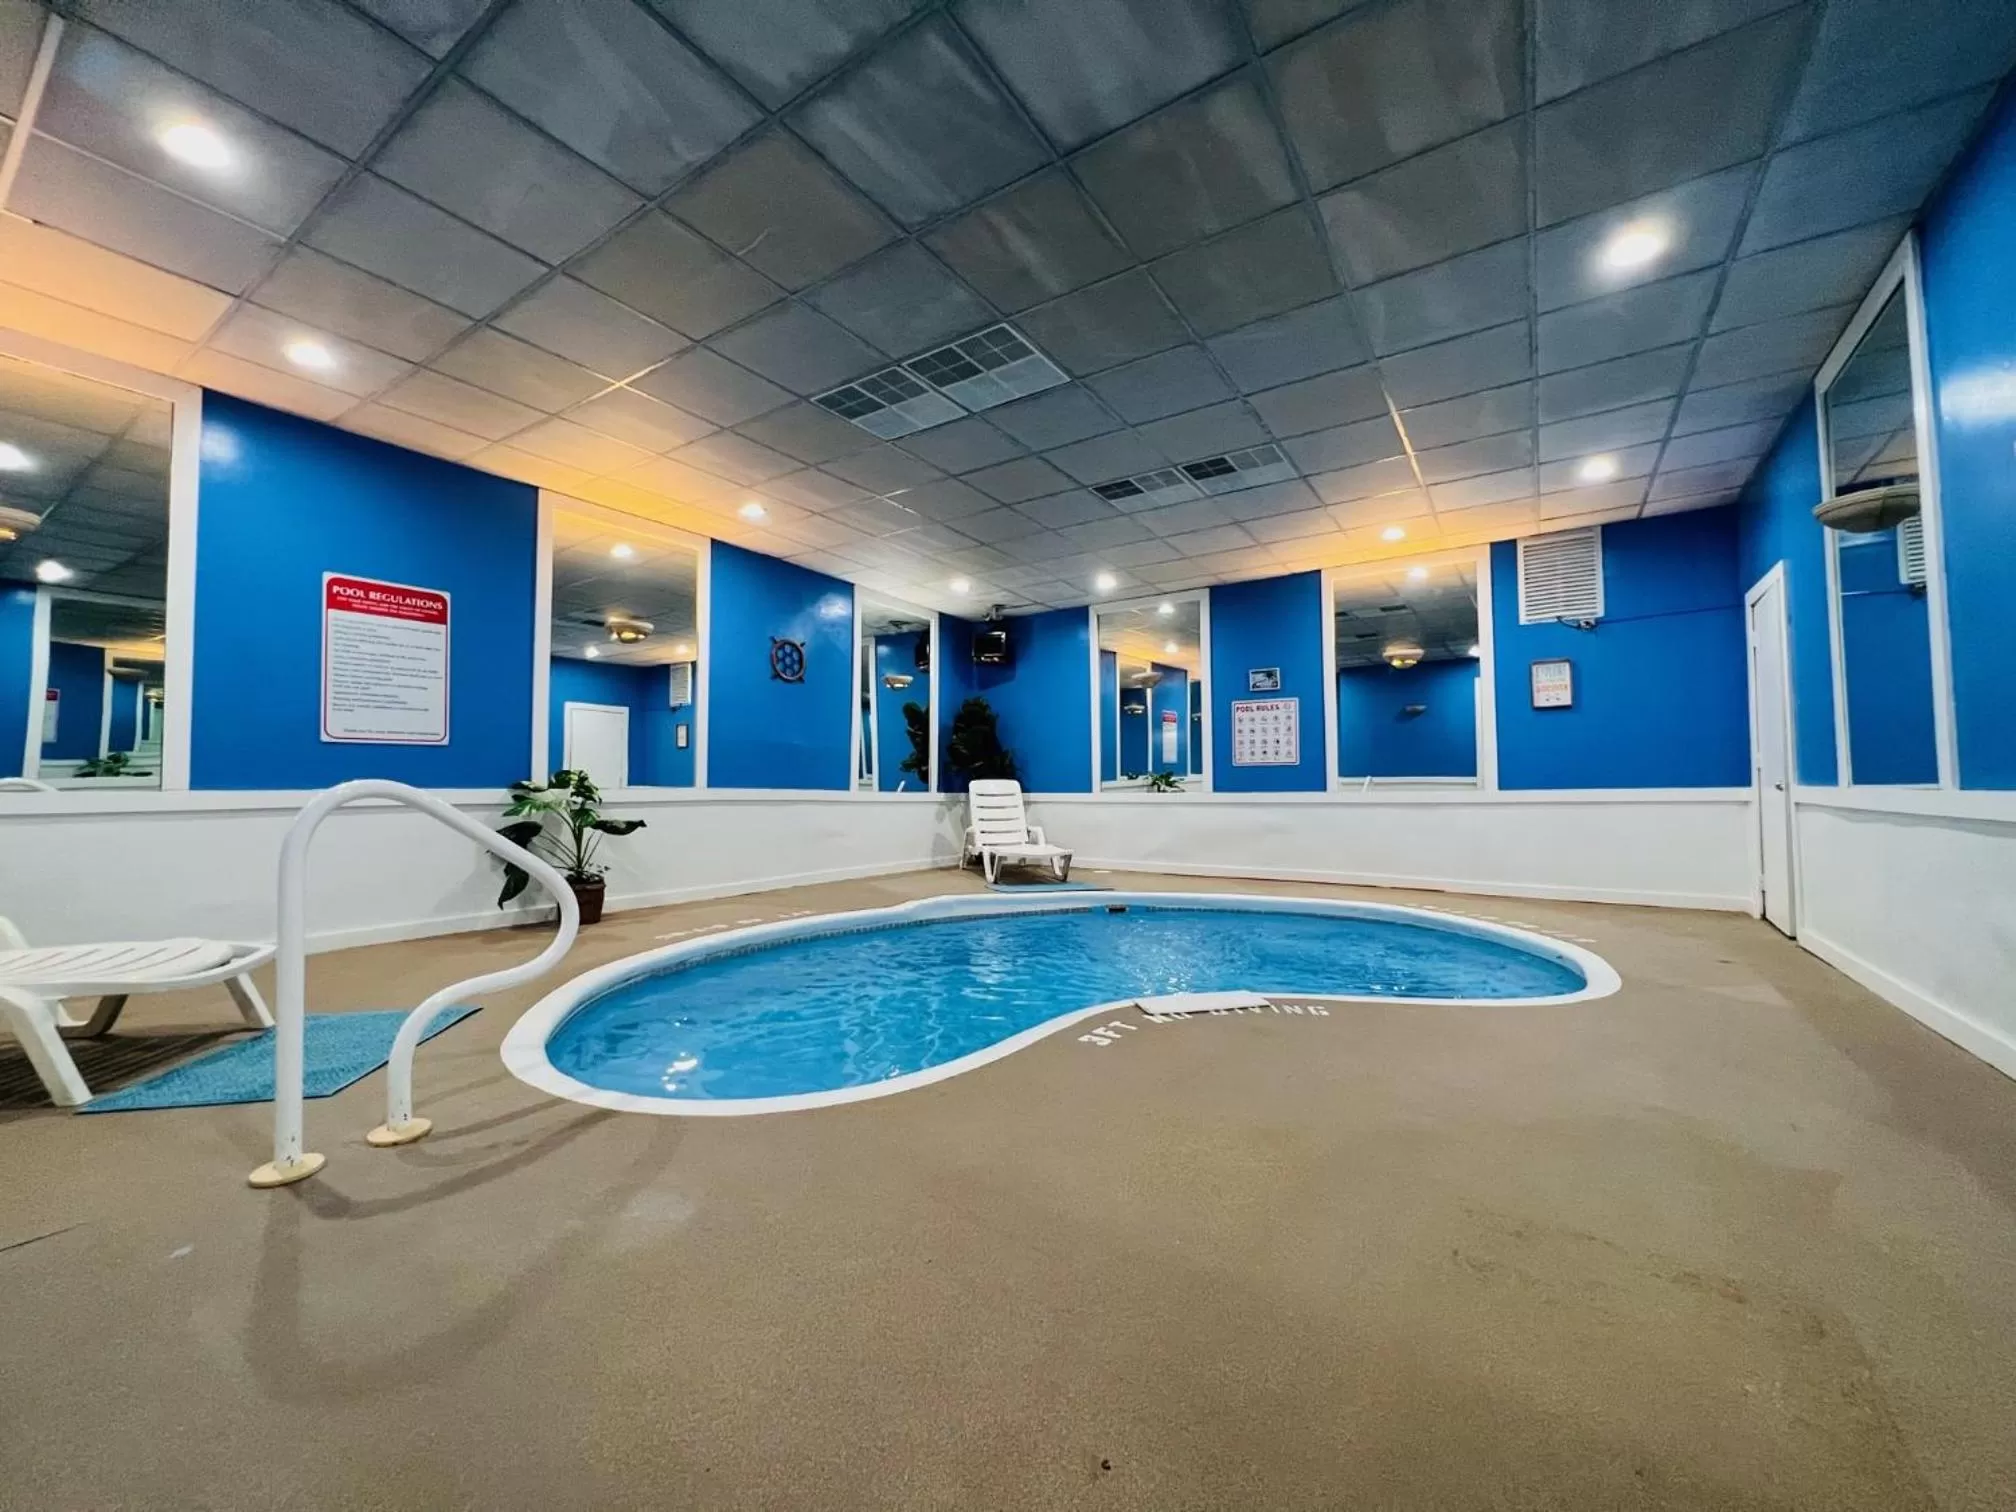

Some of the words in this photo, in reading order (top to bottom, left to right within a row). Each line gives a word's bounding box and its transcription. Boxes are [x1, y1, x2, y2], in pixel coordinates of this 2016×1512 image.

[332, 585, 366, 599] POOL
[368, 590, 443, 610] REGULATIONS
[1236, 705, 1254, 713] POOL
[1256, 703, 1280, 713] RULES
[1077, 1020, 1139, 1047] 3FT
